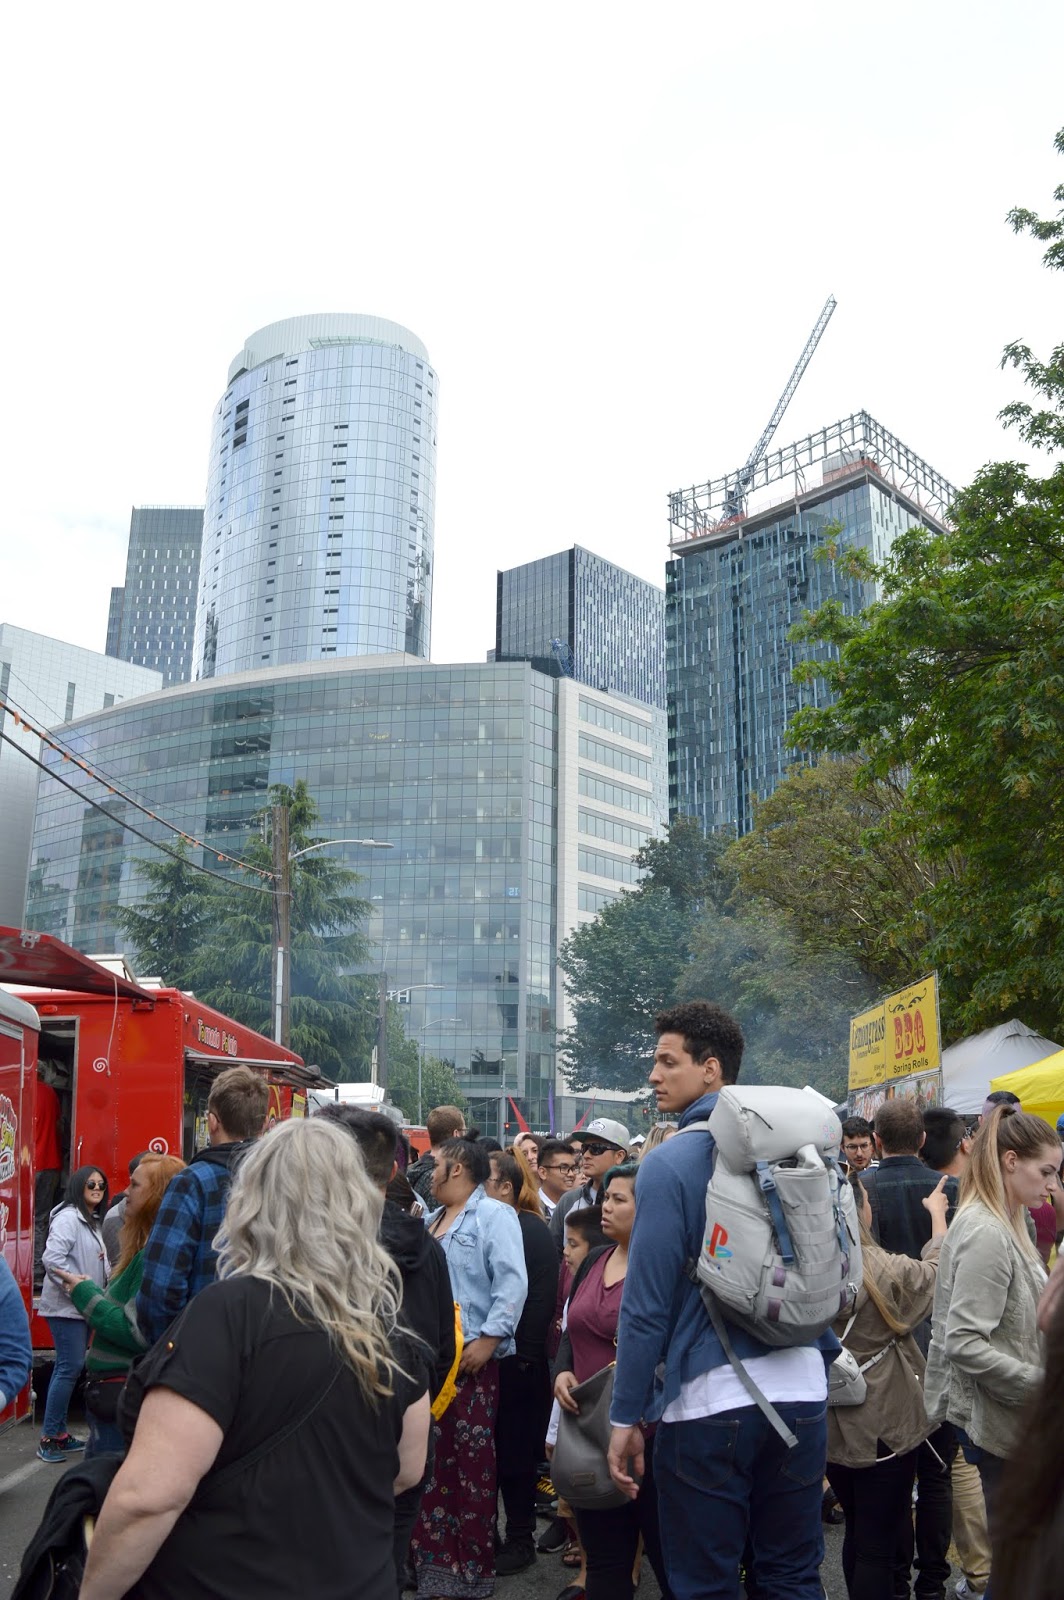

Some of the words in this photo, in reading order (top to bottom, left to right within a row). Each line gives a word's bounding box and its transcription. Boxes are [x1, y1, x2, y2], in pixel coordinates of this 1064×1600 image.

[894, 1009, 926, 1059] BBQ
[893, 1063, 912, 1074] Spring
[912, 1058, 929, 1068] Rolls
